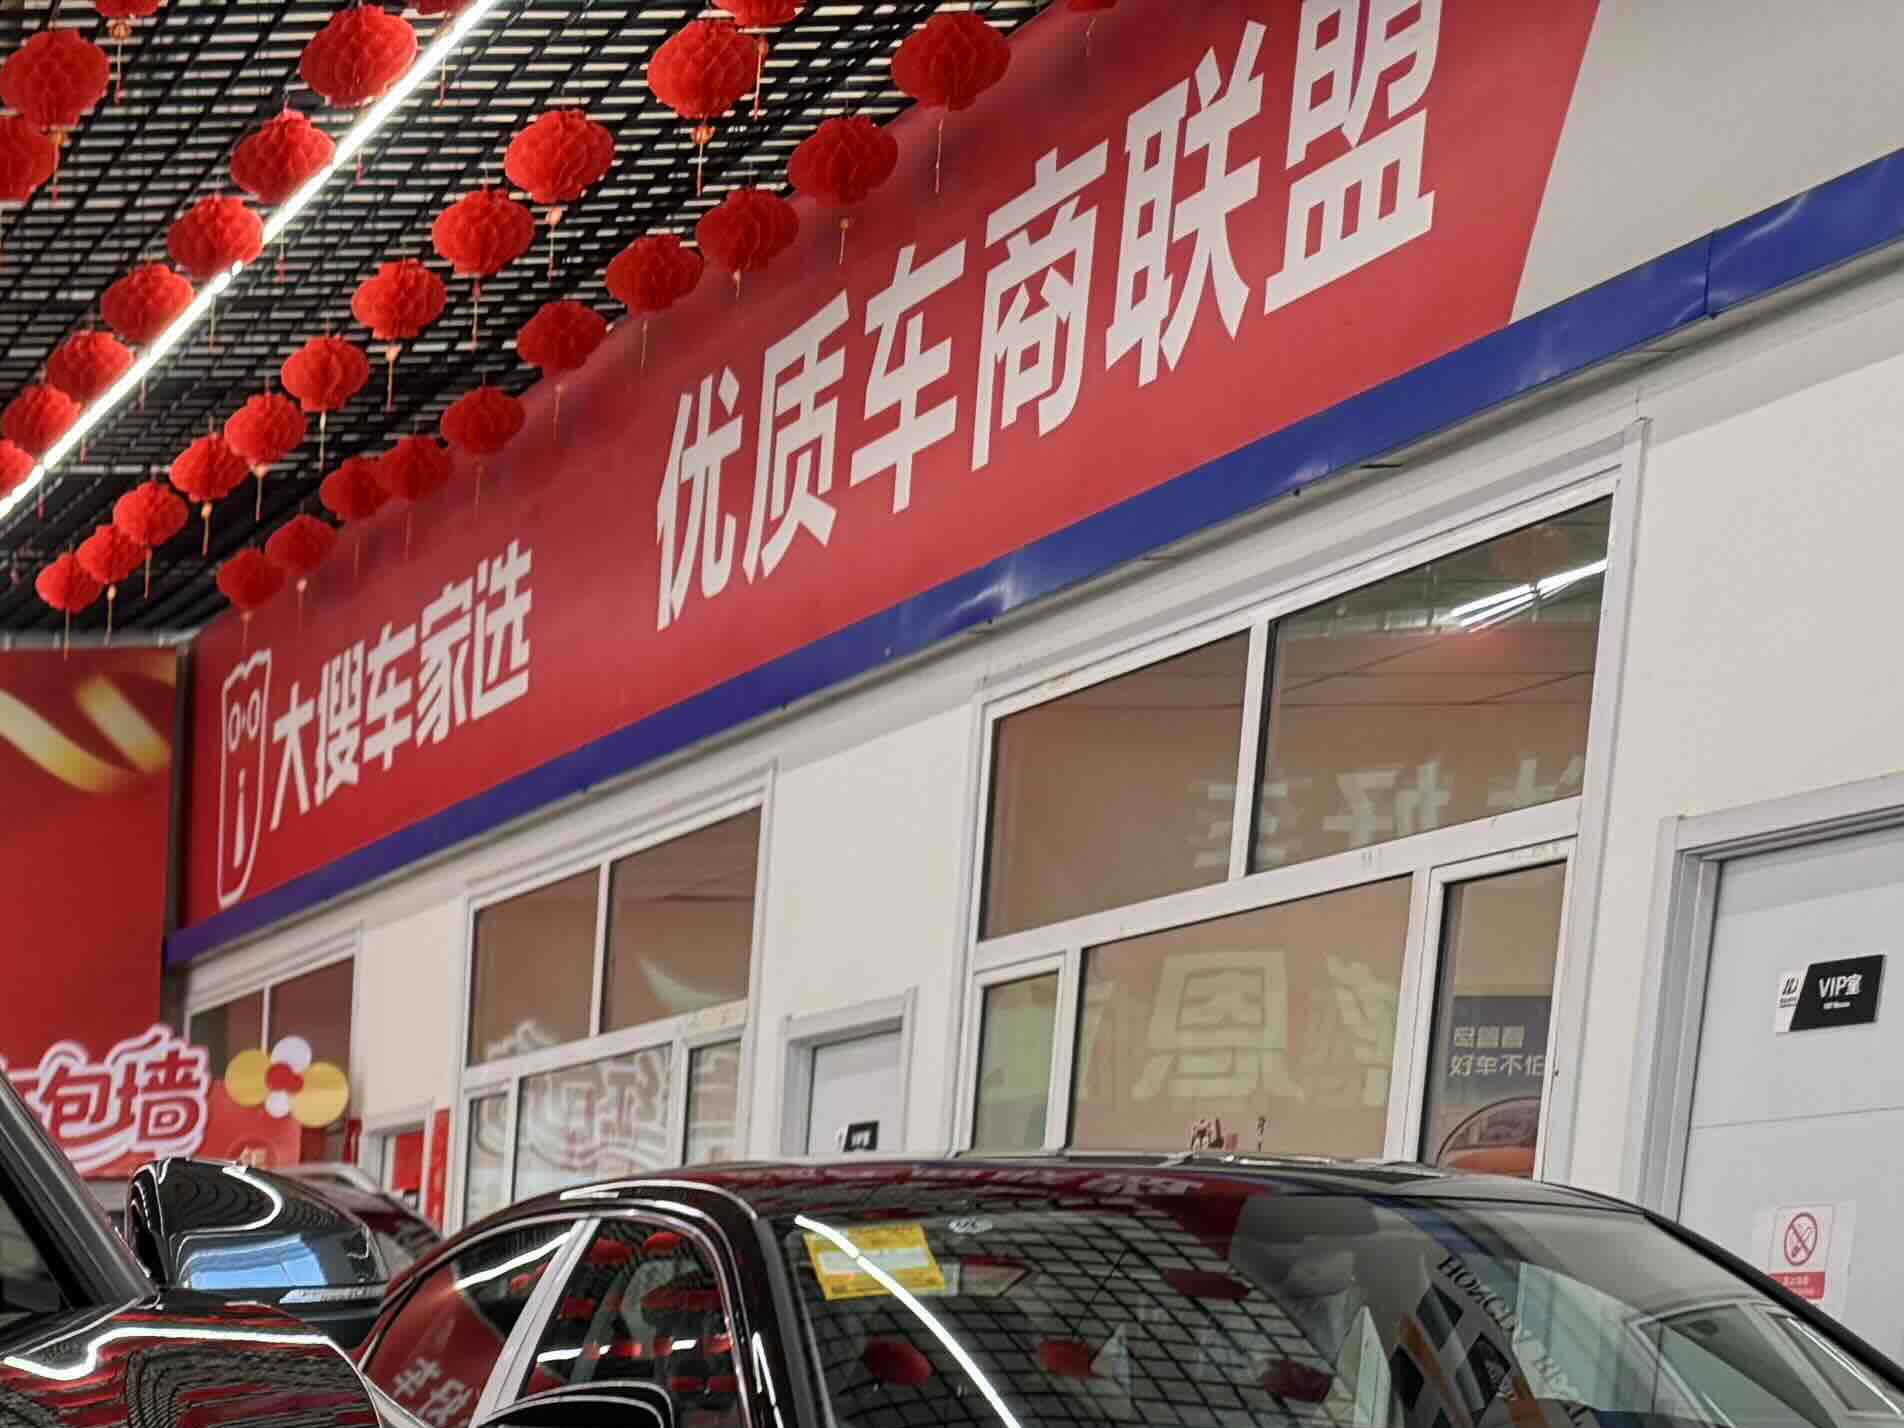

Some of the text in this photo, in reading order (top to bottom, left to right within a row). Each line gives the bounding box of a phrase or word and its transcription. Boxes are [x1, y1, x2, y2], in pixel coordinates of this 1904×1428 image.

[657, 0, 1443, 631] 优质车商联盟
[270, 539, 533, 832] 大搜车家选
